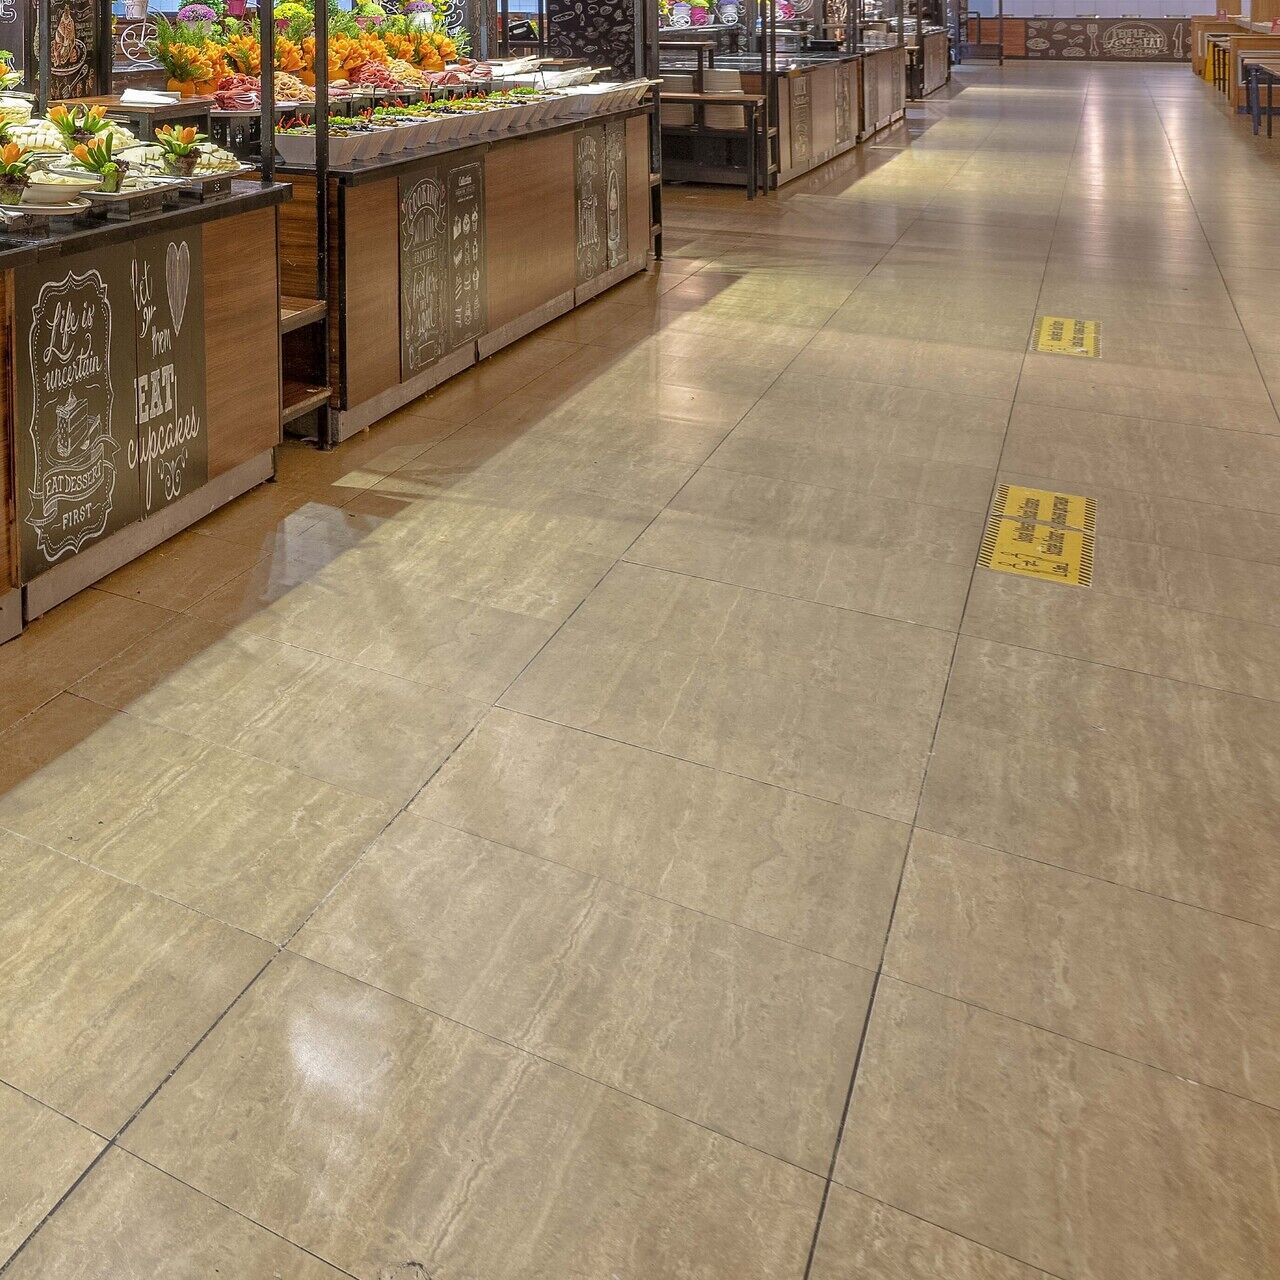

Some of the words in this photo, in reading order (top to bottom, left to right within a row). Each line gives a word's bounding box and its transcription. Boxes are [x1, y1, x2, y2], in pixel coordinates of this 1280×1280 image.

[43, 300, 79, 363] Life
[81, 302, 96, 331] is
[151, 324, 172, 360] them
[43, 350, 103, 393] uncertain
[133, 363, 175, 425] EAT
[127, 375, 200, 510] cupcakes
[45, 474, 64, 500] EAT
[64, 466, 103, 495] DESSERT
[61, 508, 93, 531] FIRST
